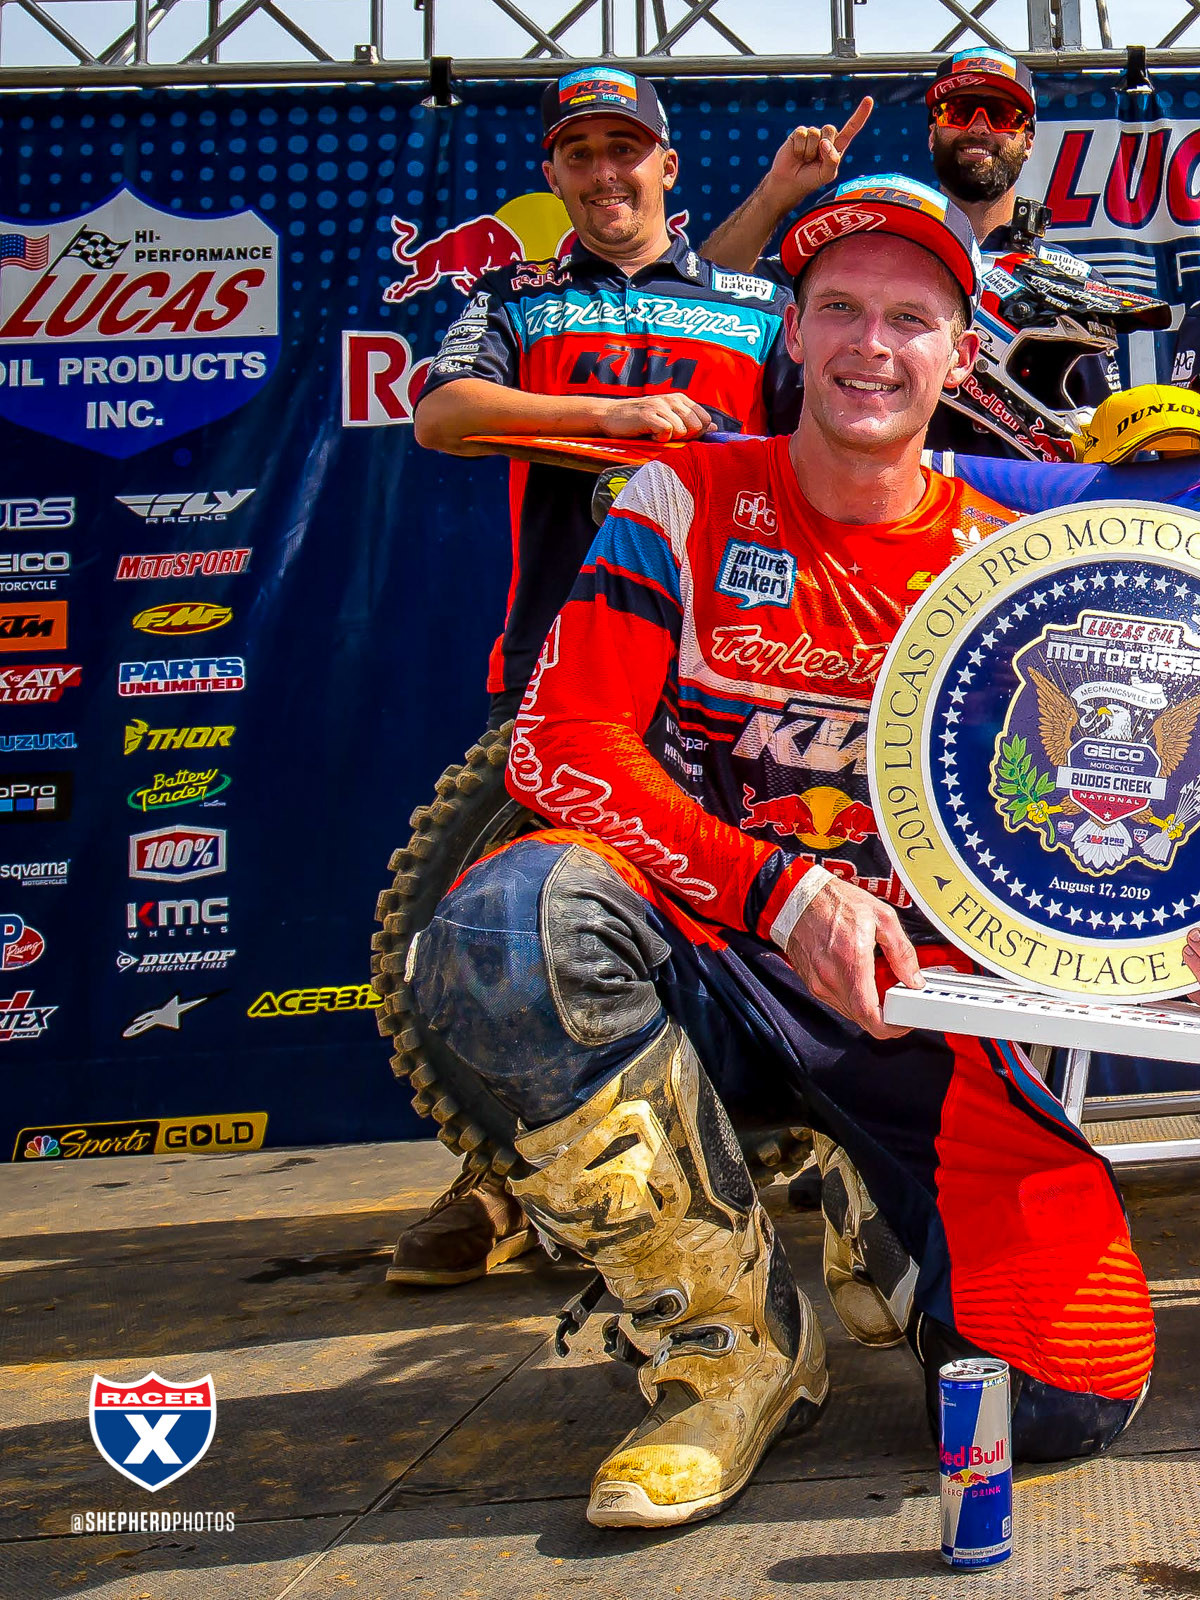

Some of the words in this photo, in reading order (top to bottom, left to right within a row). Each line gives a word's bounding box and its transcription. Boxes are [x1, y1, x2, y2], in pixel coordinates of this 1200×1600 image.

[135, 230, 161, 244] HI-
[135, 246, 272, 263] PERFORMANCE
[1, 268, 266, 338] LUCAS
[58, 352, 266, 385] PRODUCTS
[569, 343, 699, 389] KTM
[86, 400, 164, 429] INC.
[0, 497, 75, 529] PS
[150, 489, 256, 517] FLY
[146, 513, 228, 525] RACING
[0, 552, 70, 572] EICO
[978, 532, 1053, 588] PRO
[0, 580, 57, 591] TORCYCLE
[728, 565, 788, 598] bakery
[133, 605, 233, 631] FMF
[926, 583, 983, 638] OIL
[1087, 619, 1146, 641] LUCAS
[1148, 627, 1176, 645] OIL
[19, 667, 83, 688] ATV
[119, 657, 244, 683] PARTS
[17, 686, 57, 701] OUT
[119, 678, 244, 696] UNLIMITED
[884, 643, 936, 771] LUCAS
[0, 732, 75, 751] UZUKI
[147, 725, 236, 751] THOR
[1083, 743, 1144, 762] GEICO
[152, 768, 219, 792] Battery
[1090, 762, 1135, 773] MOTORCYCLE
[0, 785, 56, 797] oPro
[1070, 772, 1111, 788] BUDDS
[1112, 777, 1153, 795] CREEK
[137, 785, 209, 812] Tender
[1079, 791, 1141, 806] NATIONAL
[888, 785, 936, 862] 2019
[143, 837, 216, 869] 100%
[0, 861, 68, 880] sqvarna
[1048, 876, 1095, 894] August
[1099, 883, 1117, 898] 17,
[1120, 886, 1151, 900] 2019
[0, 914, 24, 969] P
[127, 926, 229, 940] WHEELS
[947, 890, 1049, 968] FIRST
[1050, 947, 1169, 986] PLACE
[136, 962, 197, 974] MOTORCYCLE
[200, 960, 228, 970] TIRES
[140, 949, 237, 965] DUNLOP
[60, 1128, 152, 1160] Sports
[164, 1121, 254, 1149] GOLD
[968, 1439, 1005, 1467] Bull
[972, 1486, 1001, 1498] DRINK
